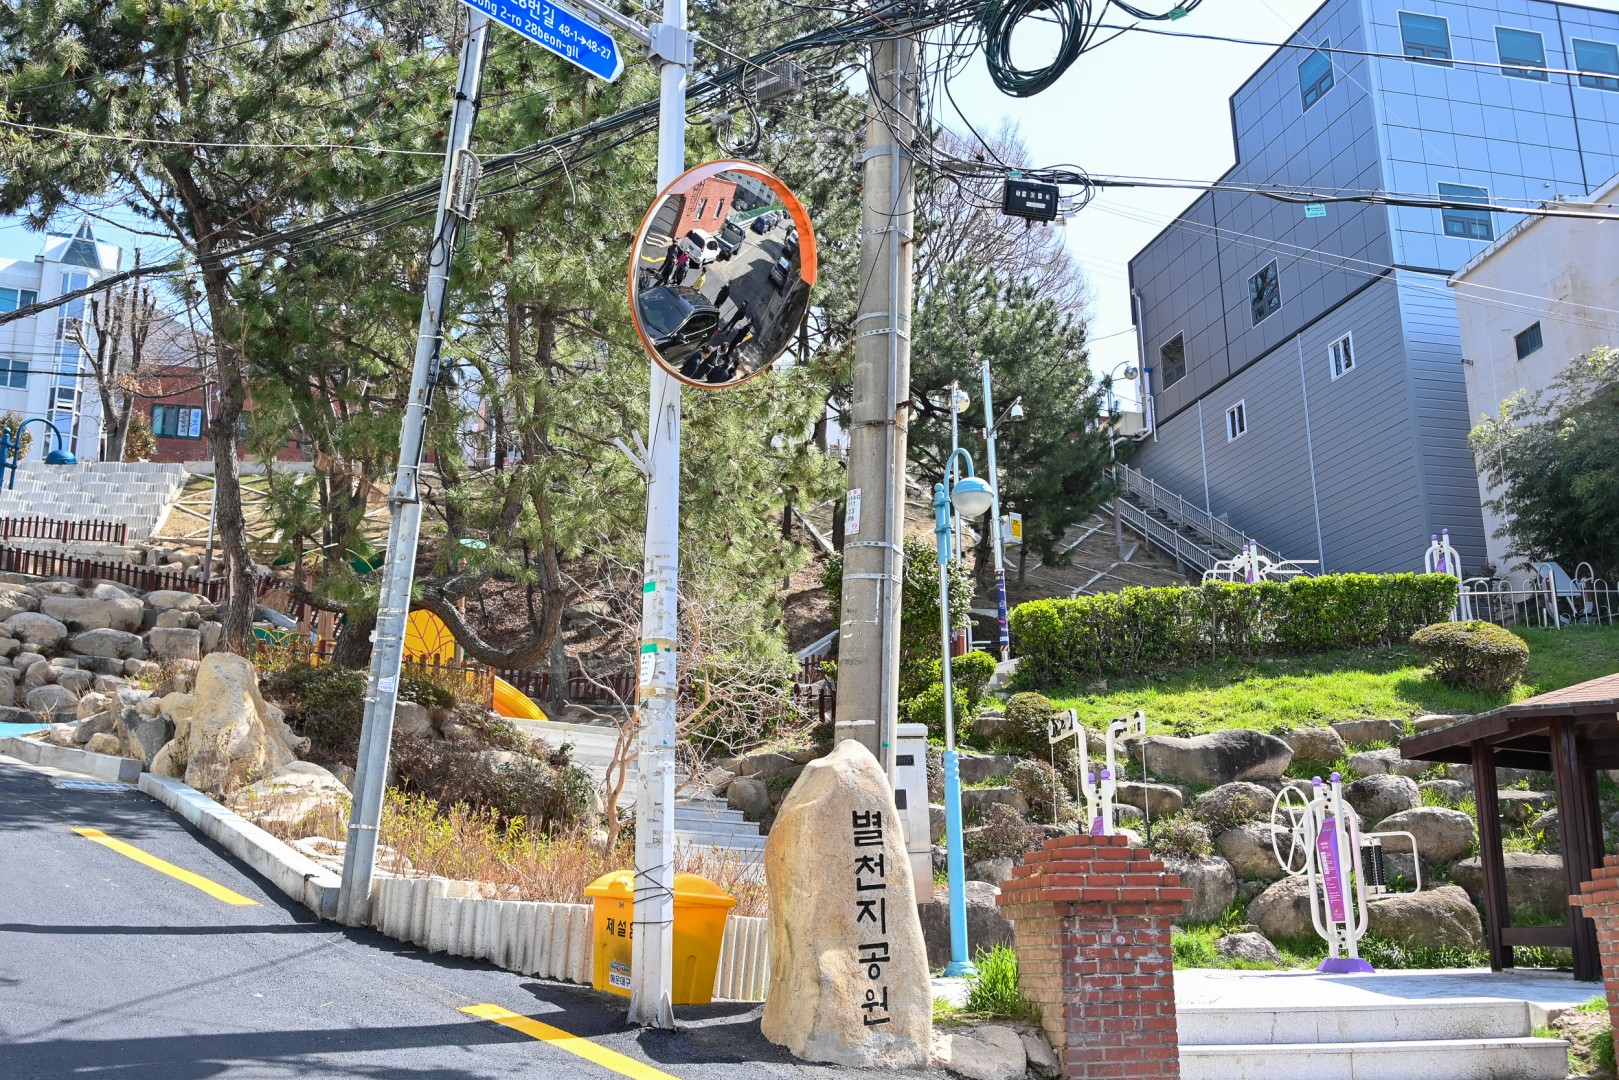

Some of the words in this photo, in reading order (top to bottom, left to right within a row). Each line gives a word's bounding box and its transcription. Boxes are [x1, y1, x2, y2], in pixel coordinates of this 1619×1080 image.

[472, 0, 497, 16] ong
[500, 5, 522, 27] 2-ro
[525, 19, 579, 59] 28beon-gil
[851, 810, 891, 1027] 별천지공원
